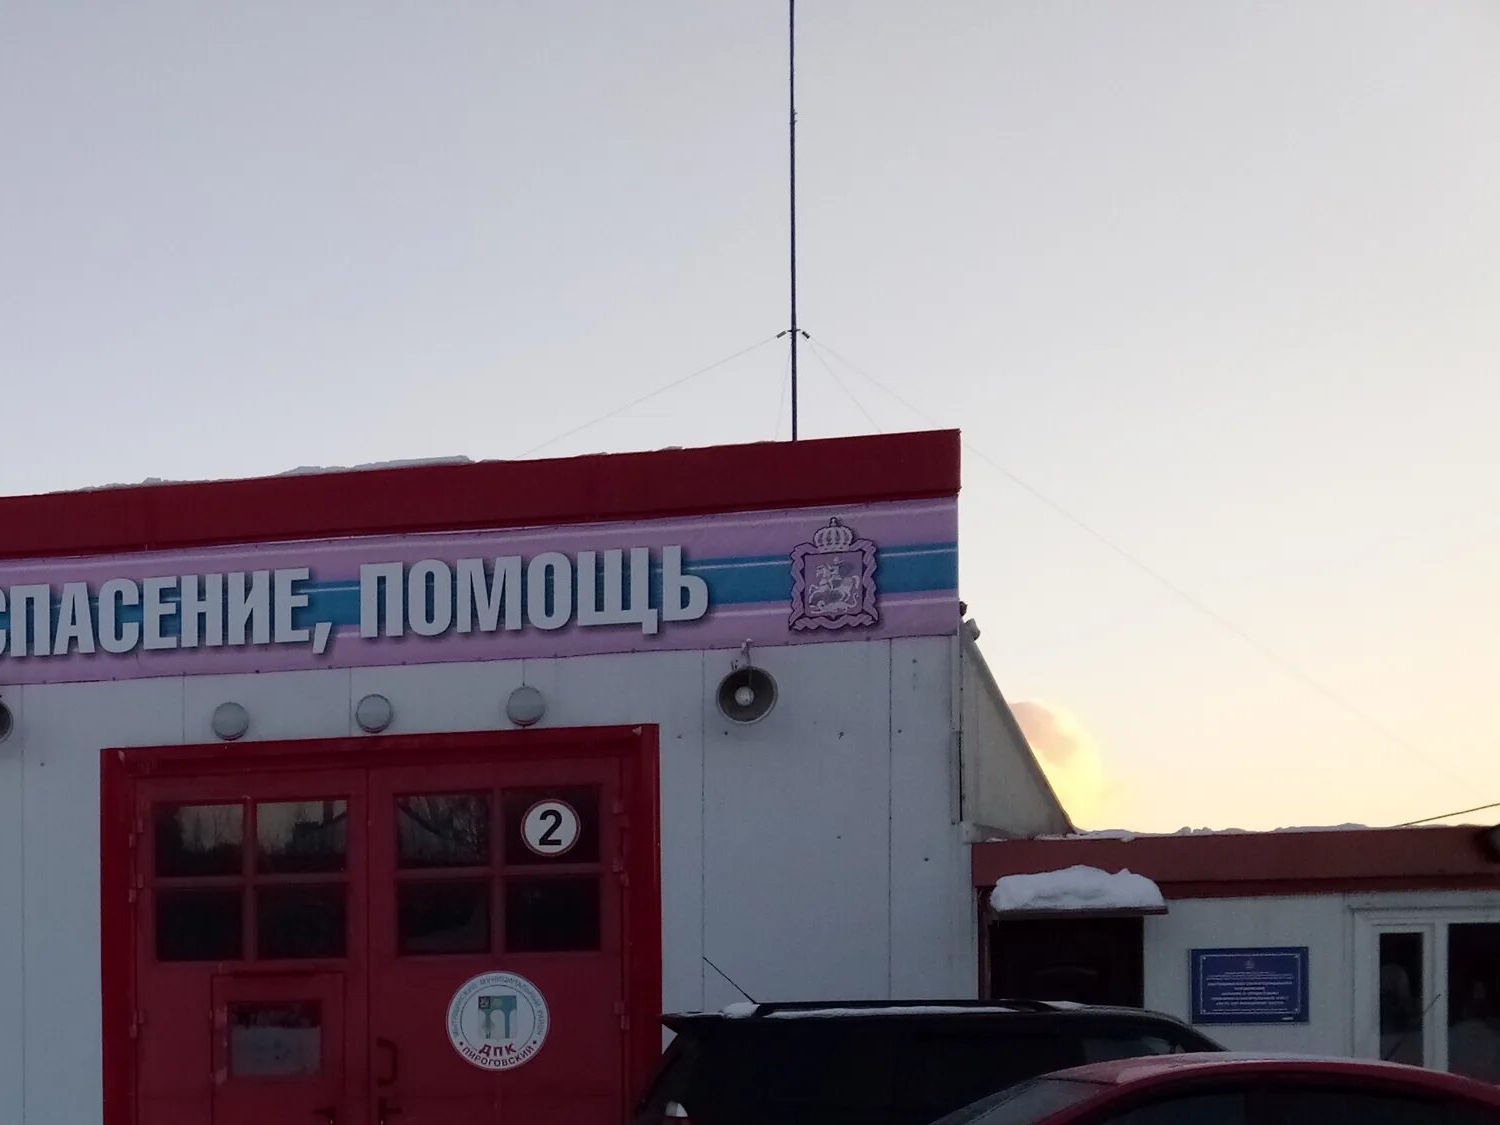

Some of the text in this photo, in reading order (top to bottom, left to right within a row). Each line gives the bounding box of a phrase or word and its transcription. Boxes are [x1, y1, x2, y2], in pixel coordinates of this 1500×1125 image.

[360, 544, 709, 639] ПОМОЩЬ
[538, 809, 563, 846] 2
[462, 1045, 535, 1068] ПИРОГОВСКИЙ
[478, 1043, 517, 1057] ДПК
